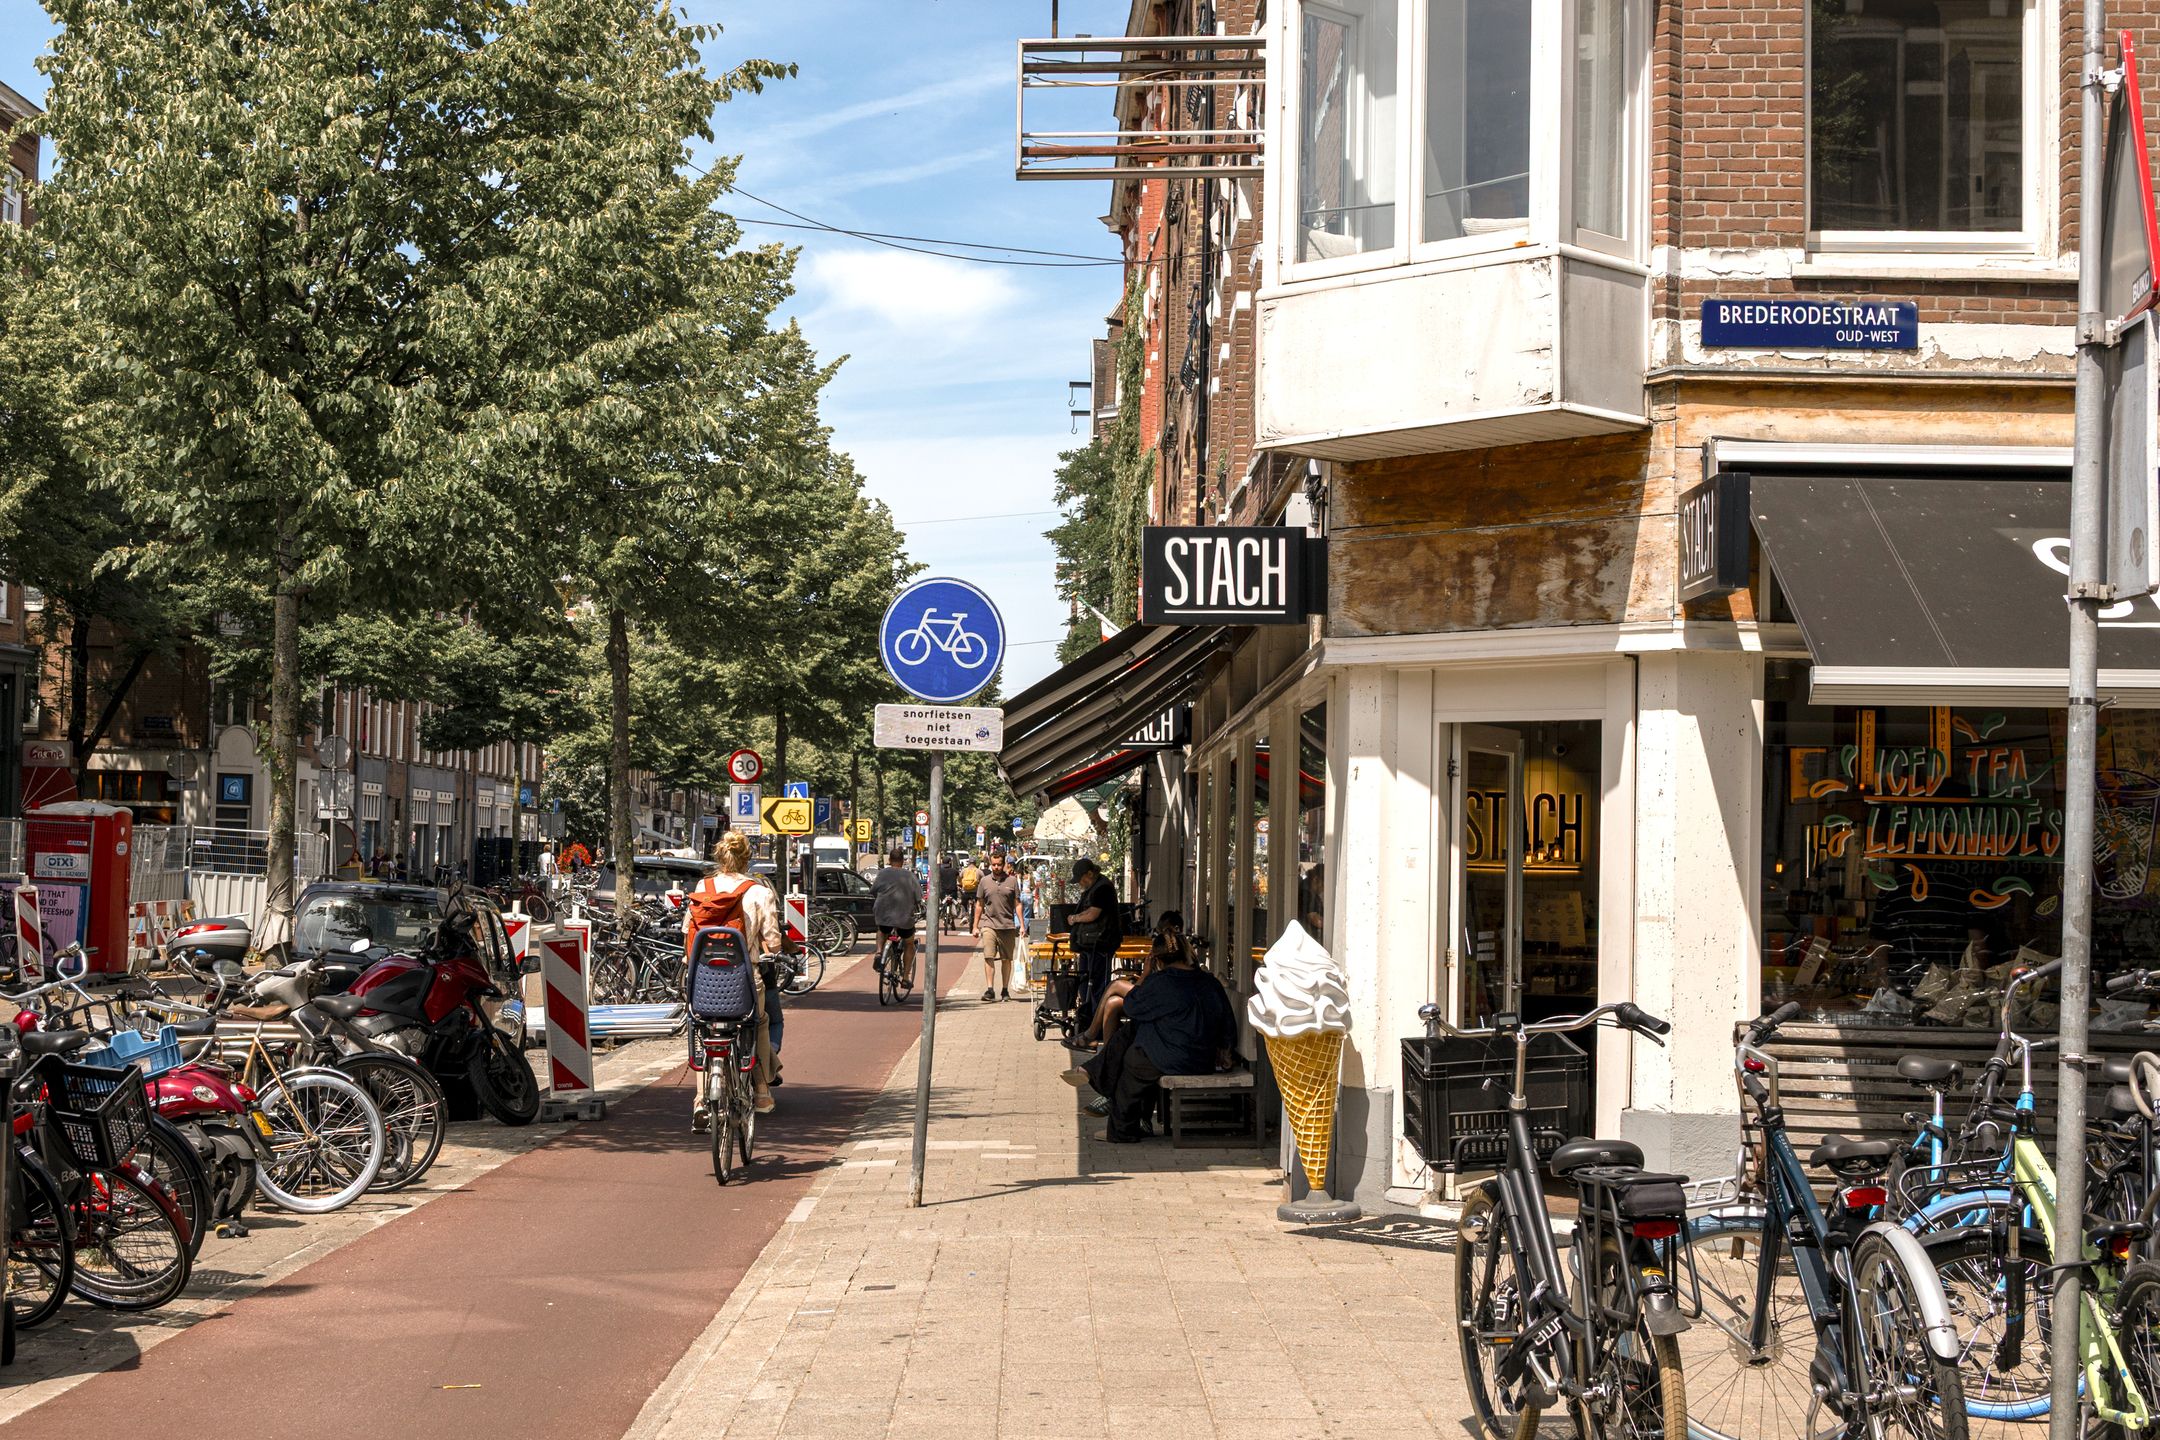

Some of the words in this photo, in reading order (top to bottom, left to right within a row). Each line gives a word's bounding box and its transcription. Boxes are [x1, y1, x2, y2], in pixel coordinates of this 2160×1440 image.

[2132, 269, 2150, 304] BUKO
[1719, 305, 1900, 326] BREDERODESTRAAT
[1835, 330, 1900, 343] OUD-WEST
[1683, 489, 1714, 580] STACH
[1164, 536, 1286, 607] STACH
[903, 709, 972, 720] snorfietsen
[926, 722, 951, 732] niet
[904, 734, 971, 746] toegestaan
[735, 760, 757, 772] 30
[1874, 746, 1947, 797] ICED
[1965, 746, 2032, 799] TEA
[741, 794, 750, 806] P
[818, 805, 826, 816] P
[858, 824, 866, 836] S
[1466, 790, 1583, 863] STCH
[1864, 805, 2063, 857] LEMONADES
[47, 890, 66, 899] THAT
[48, 899, 58, 907] OF
[40, 907, 74, 917] FFEESHOP
